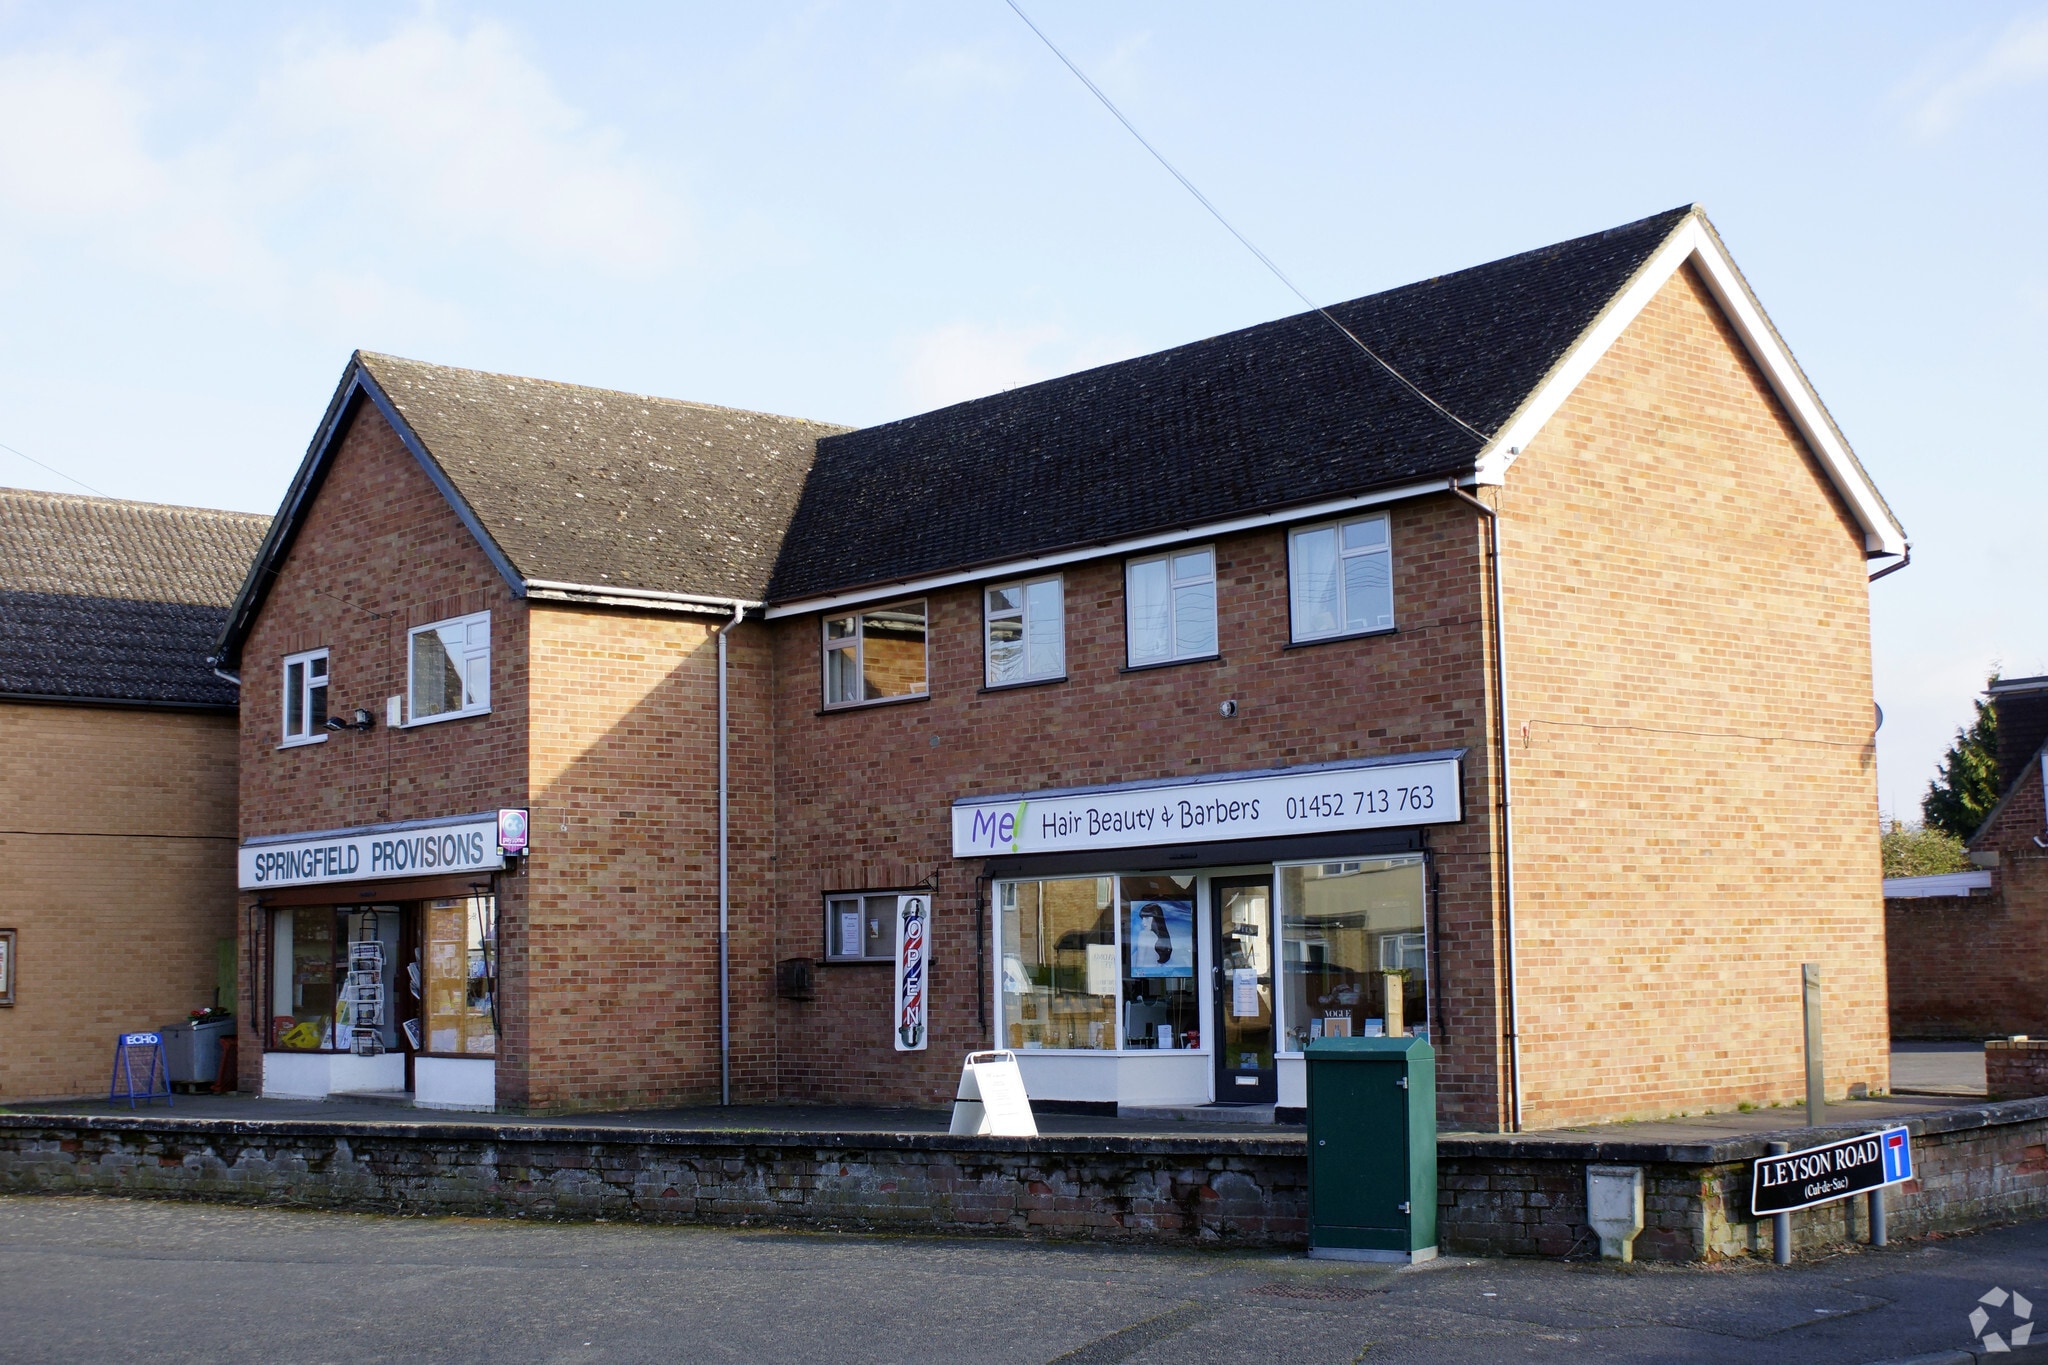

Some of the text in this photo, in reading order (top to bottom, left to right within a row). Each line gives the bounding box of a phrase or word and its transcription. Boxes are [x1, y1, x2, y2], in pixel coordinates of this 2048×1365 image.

[972, 800, 1027, 853] Me!
[1043, 811, 1082, 839] Hair
[1086, 807, 1155, 836] Beauty
[1177, 798, 1260, 829] Barbers
[1286, 793, 1344, 820] 01452
[1353, 789, 1389, 815] 713
[1397, 785, 1434, 811] 763
[255, 832, 483, 882] SPRINGFIELD PROVISIONS
[906, 919, 922, 1026] OPEN
[1324, 1009, 1352, 1018] VOGUE
[126, 1035, 158, 1045] ECHO
[1763, 1141, 1879, 1187] LEYSON ROAD
[1804, 1176, 1848, 1199] (Cul-de-Sac)
